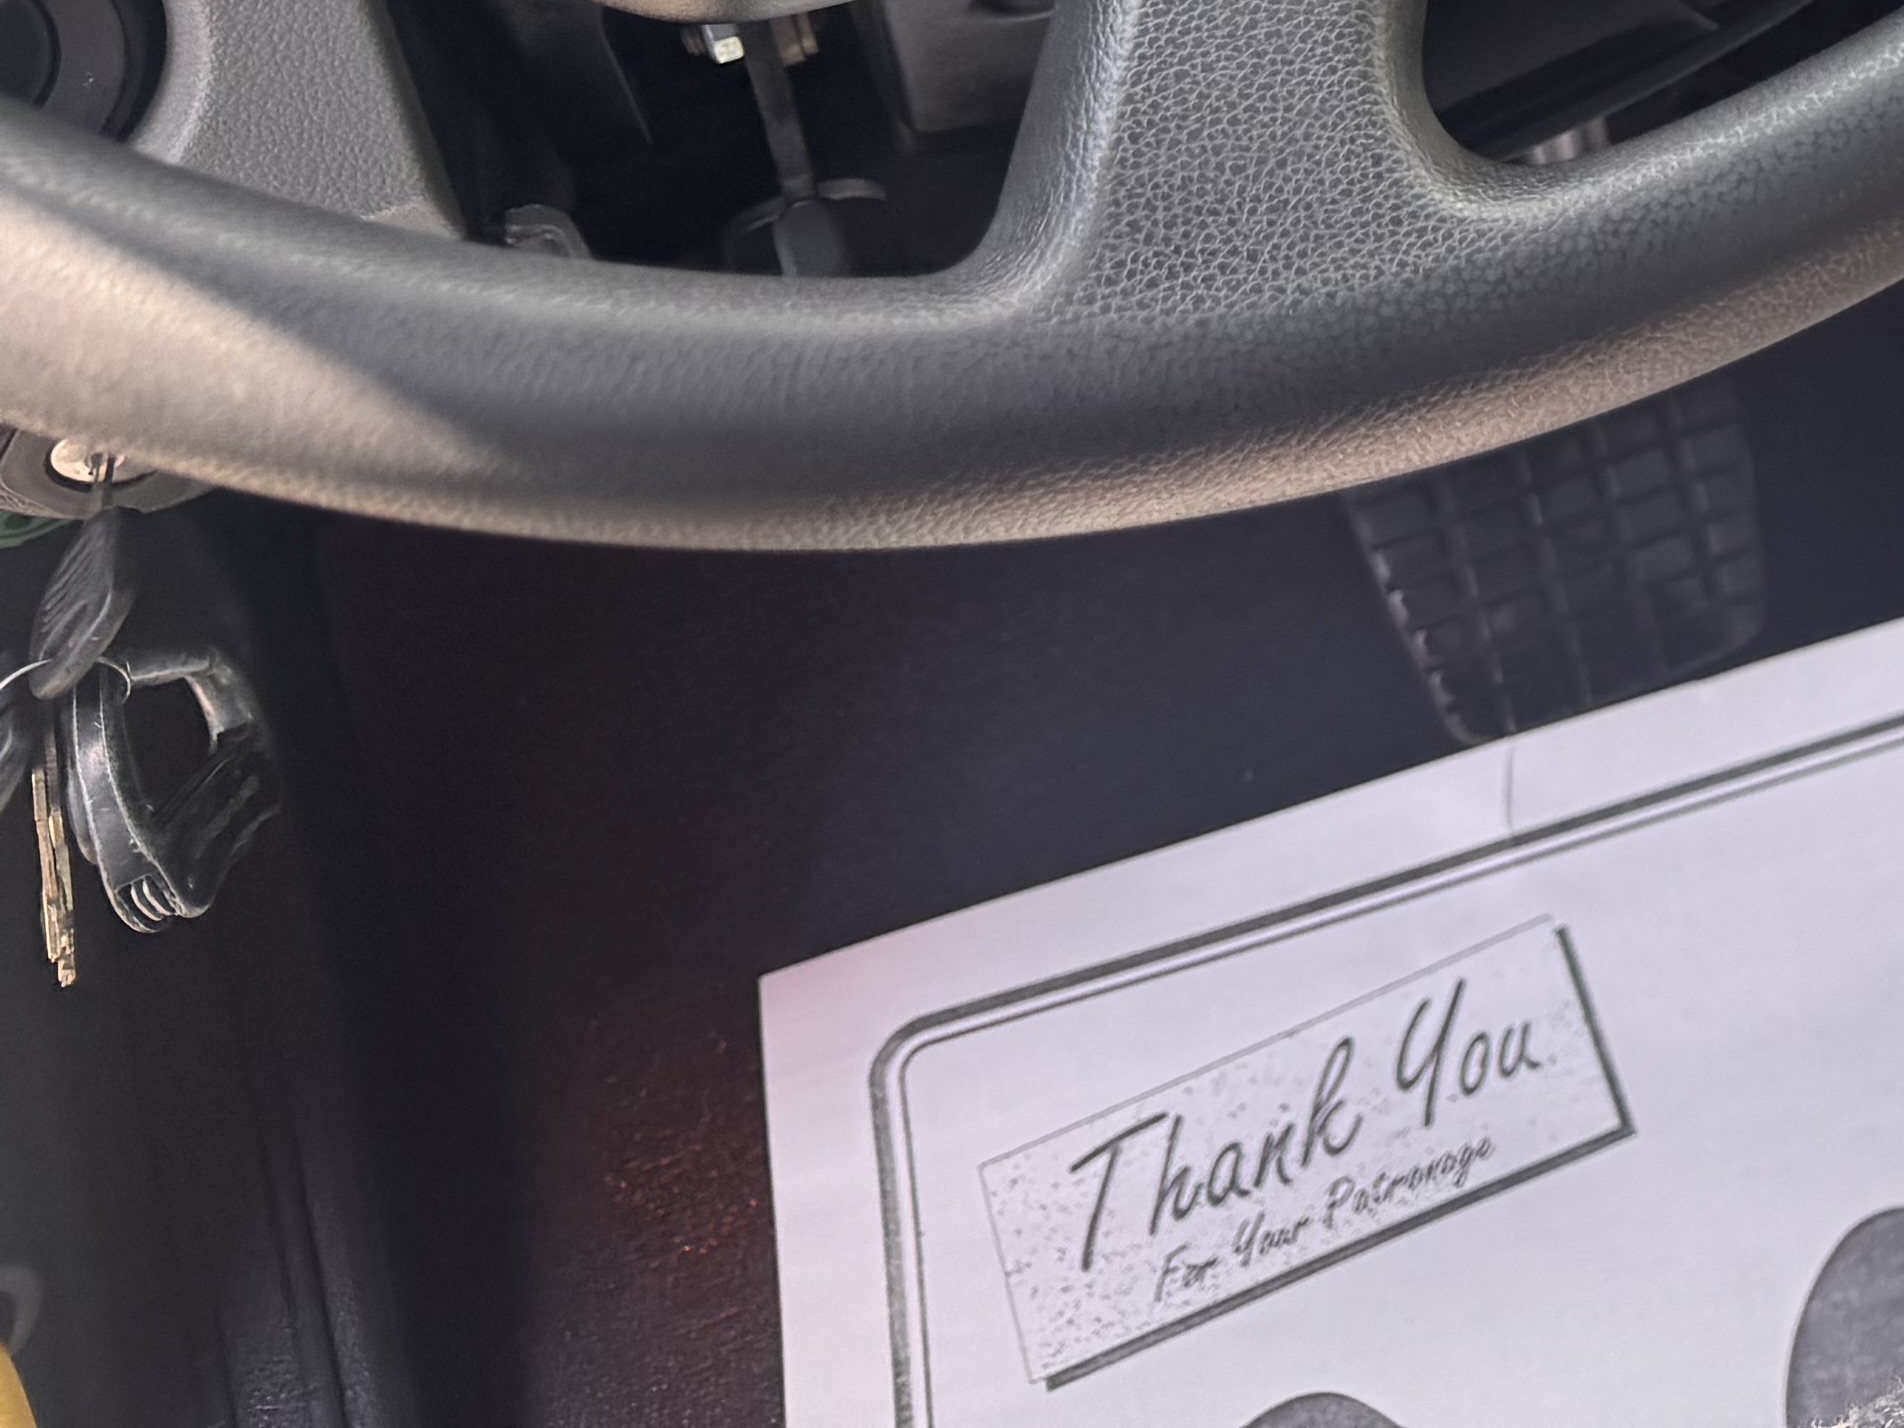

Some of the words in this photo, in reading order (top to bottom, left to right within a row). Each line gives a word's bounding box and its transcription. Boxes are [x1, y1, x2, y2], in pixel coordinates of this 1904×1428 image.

[1068, 1036, 1365, 1272] Thank
[1396, 977, 1543, 1129] You
[1153, 1242, 1219, 1303] For
[1231, 1211, 1312, 1268] Your
[1322, 1136, 1496, 1230] Patronage
